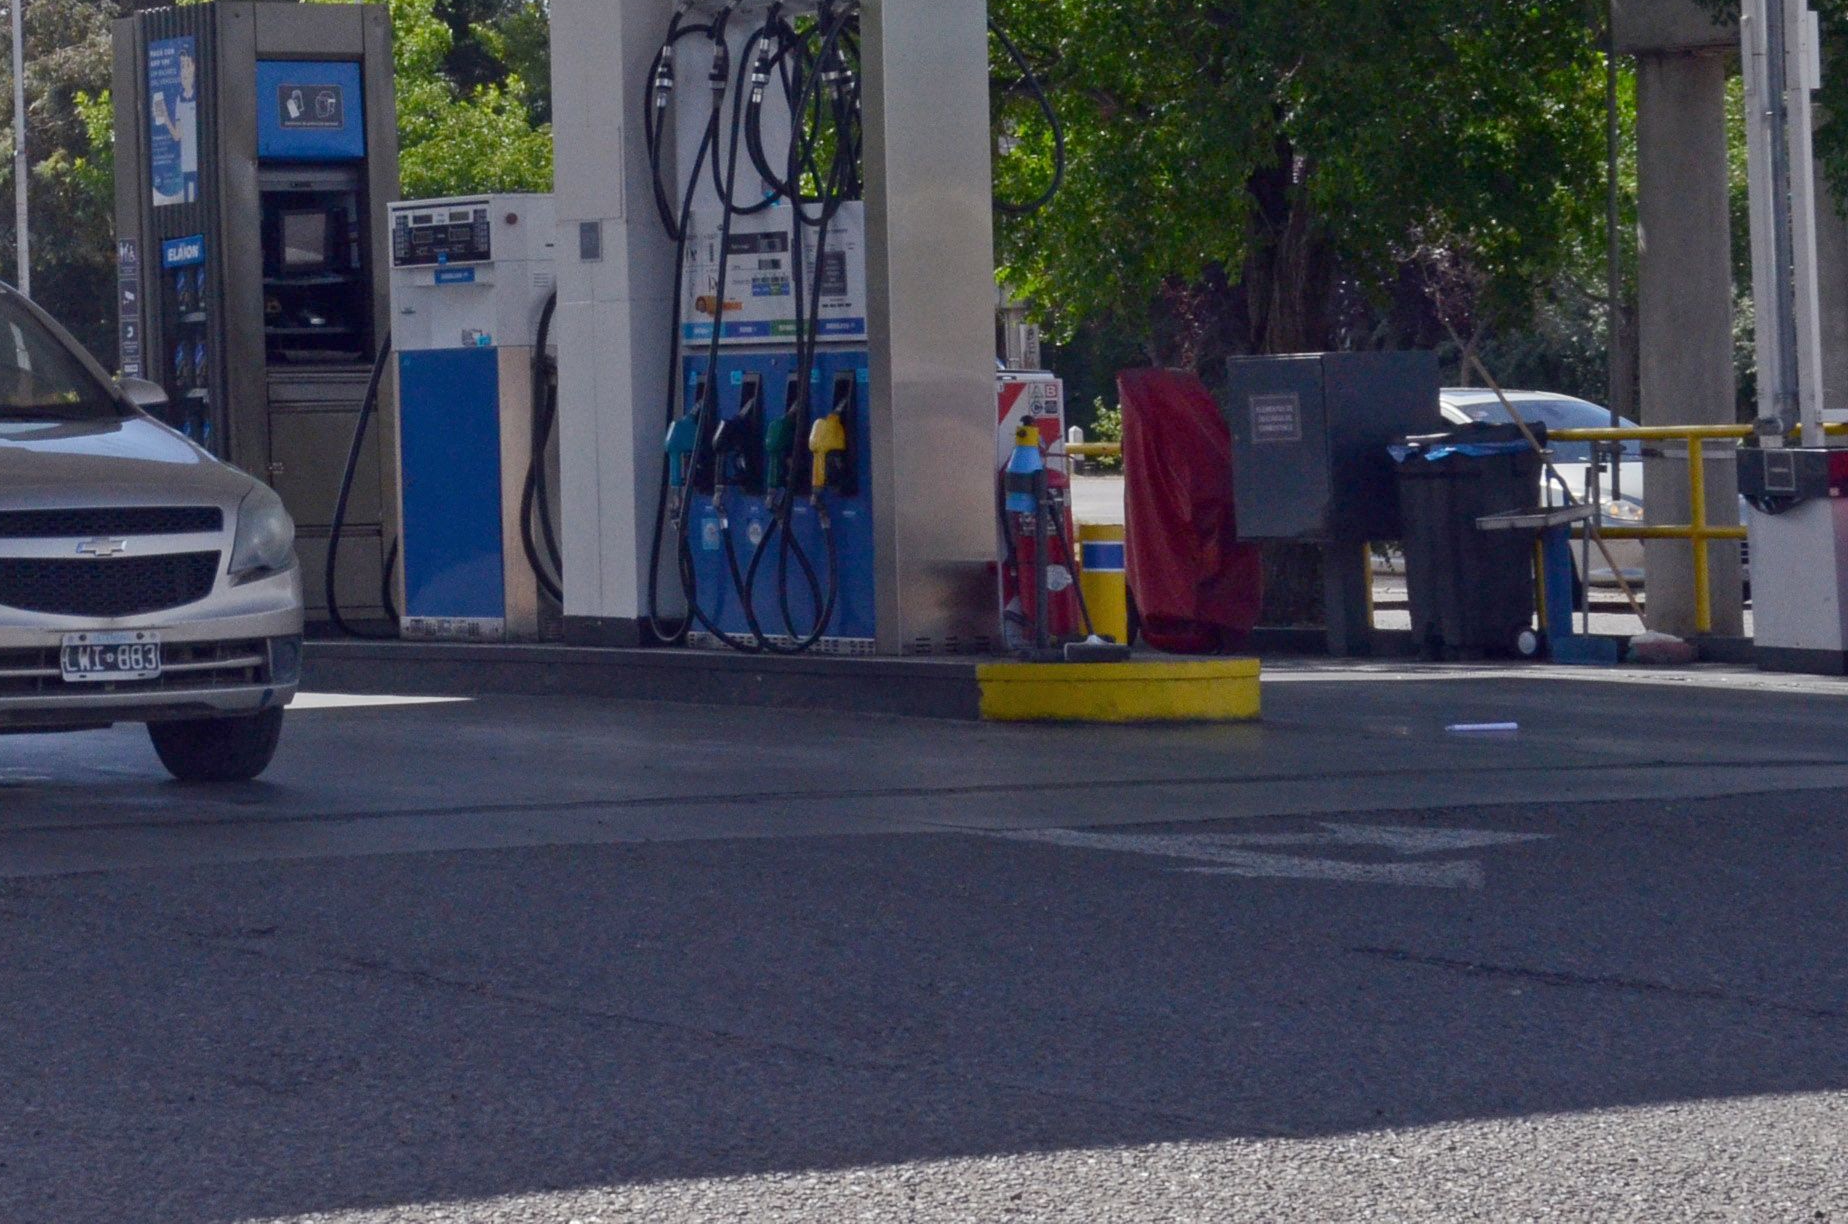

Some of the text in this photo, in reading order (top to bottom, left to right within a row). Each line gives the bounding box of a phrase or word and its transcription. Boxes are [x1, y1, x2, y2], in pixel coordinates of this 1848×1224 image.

[1045, 385, 1057, 398] B
[65, 645, 105, 671] LWI
[117, 644, 157, 670] 883
